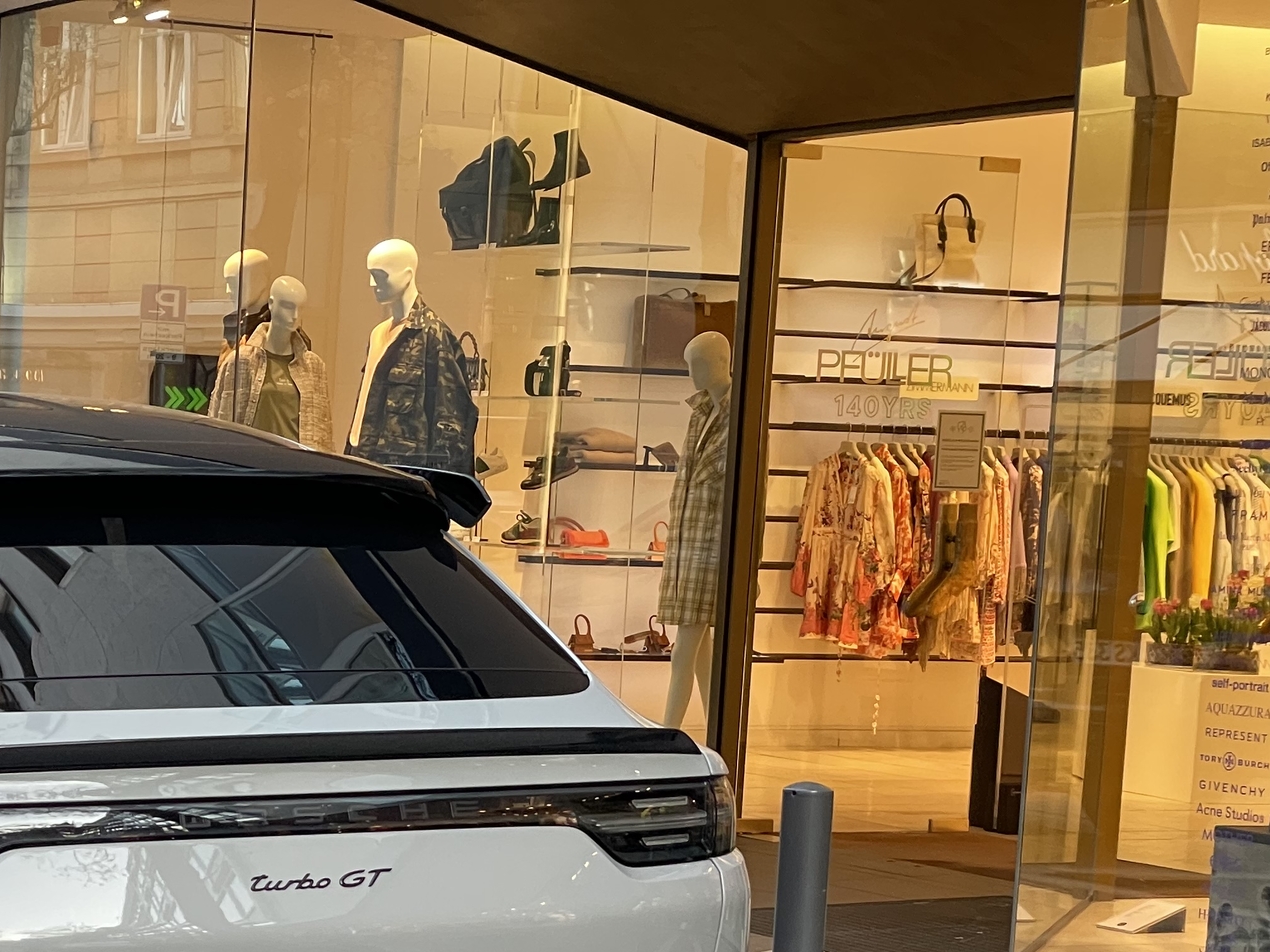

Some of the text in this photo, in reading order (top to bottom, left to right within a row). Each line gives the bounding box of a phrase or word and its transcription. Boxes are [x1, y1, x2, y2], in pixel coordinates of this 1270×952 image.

[816, 349, 953, 388] PFÜLLER
[834, 393, 932, 420] 140YRS
[1212, 678, 1269, 693] self-portrait
[1205, 702, 1270, 719] AQUAZZURA
[1205, 727, 1268, 743] REPRESENT
[1199, 754, 1270, 769] TORY BURCH
[1199, 780, 1266, 797] GIVENCHY
[1196, 803, 1265, 823] Acne Studios
[251, 868, 392, 892] turbo GT
